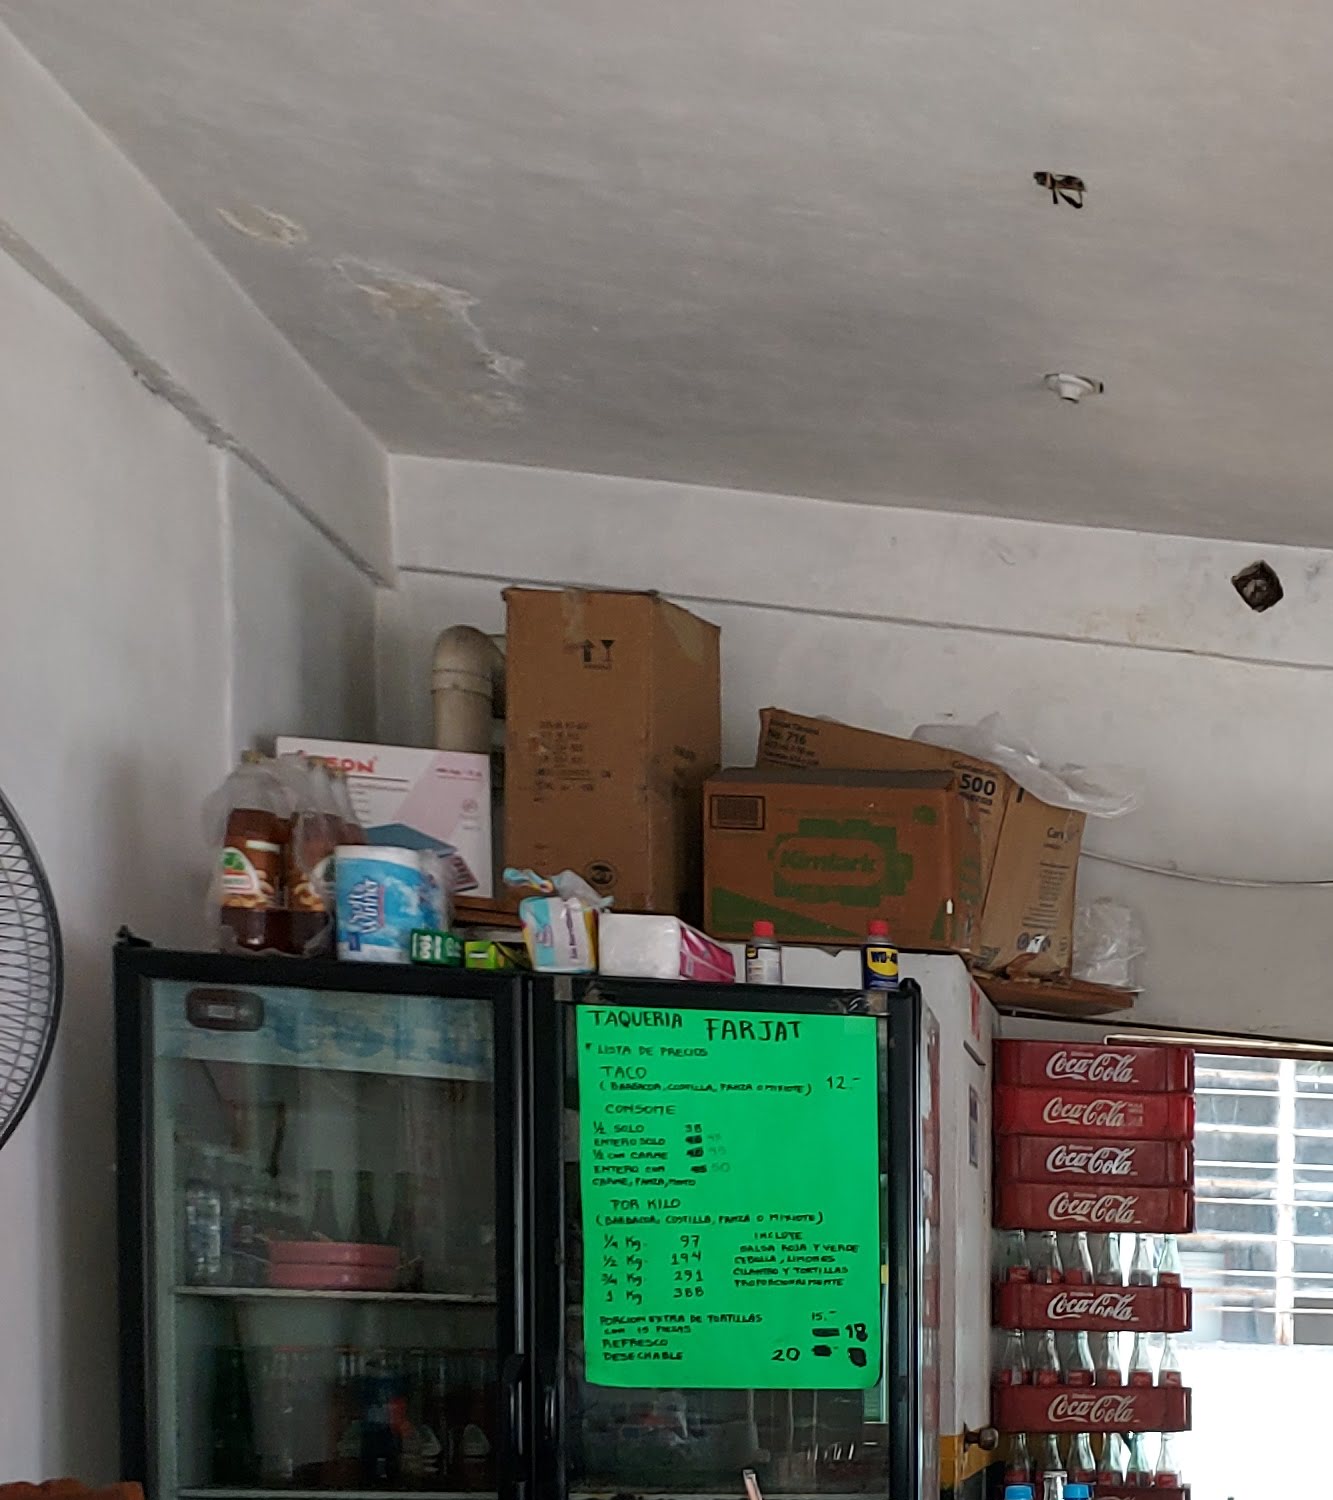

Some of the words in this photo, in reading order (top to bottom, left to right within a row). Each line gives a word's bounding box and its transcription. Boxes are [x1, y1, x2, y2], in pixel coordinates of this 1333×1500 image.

[959, 773, 996, 796] 500
[586, 1010, 683, 1029] TAQUERIA
[704, 1018, 801, 1042] FARJAT
[639, 1046, 654, 1056] DE
[660, 1047, 708, 1057] PRECIOS
[600, 1066, 647, 1080] TACO
[1046, 1051, 1137, 1083] Coca-Cola
[605, 1104, 676, 1116] CONSOME
[1043, 1096, 1128, 1127] Coca-Cola
[613, 1124, 646, 1133] SOLO
[593, 1137, 638, 1147] ENTERO
[639, 1137, 666, 1147] SOLO
[630, 1151, 668, 1160] CARNE
[1046, 1145, 1136, 1175] Coca-Cola
[593, 1165, 639, 1174] ENTERO
[610, 1198, 640, 1211] POR
[647, 1198, 681, 1210] KILO
[1048, 1191, 1139, 1224] Coca-Cola
[680, 1234, 700, 1248] 97
[822, 1243, 860, 1254] VERDE
[671, 1250, 702, 1265] 194
[673, 1269, 704, 1282] 291
[792, 1266, 849, 1275] TORTILLAS
[605, 1289, 613, 1302] 1
[707, 1313, 763, 1324] TORTILLAS
[602, 1338, 668, 1349] REFRESCO
[602, 1351, 684, 1362] DESECHABLE
[771, 1346, 801, 1362] 20
[1047, 1393, 1137, 1423] Coca-Cola
